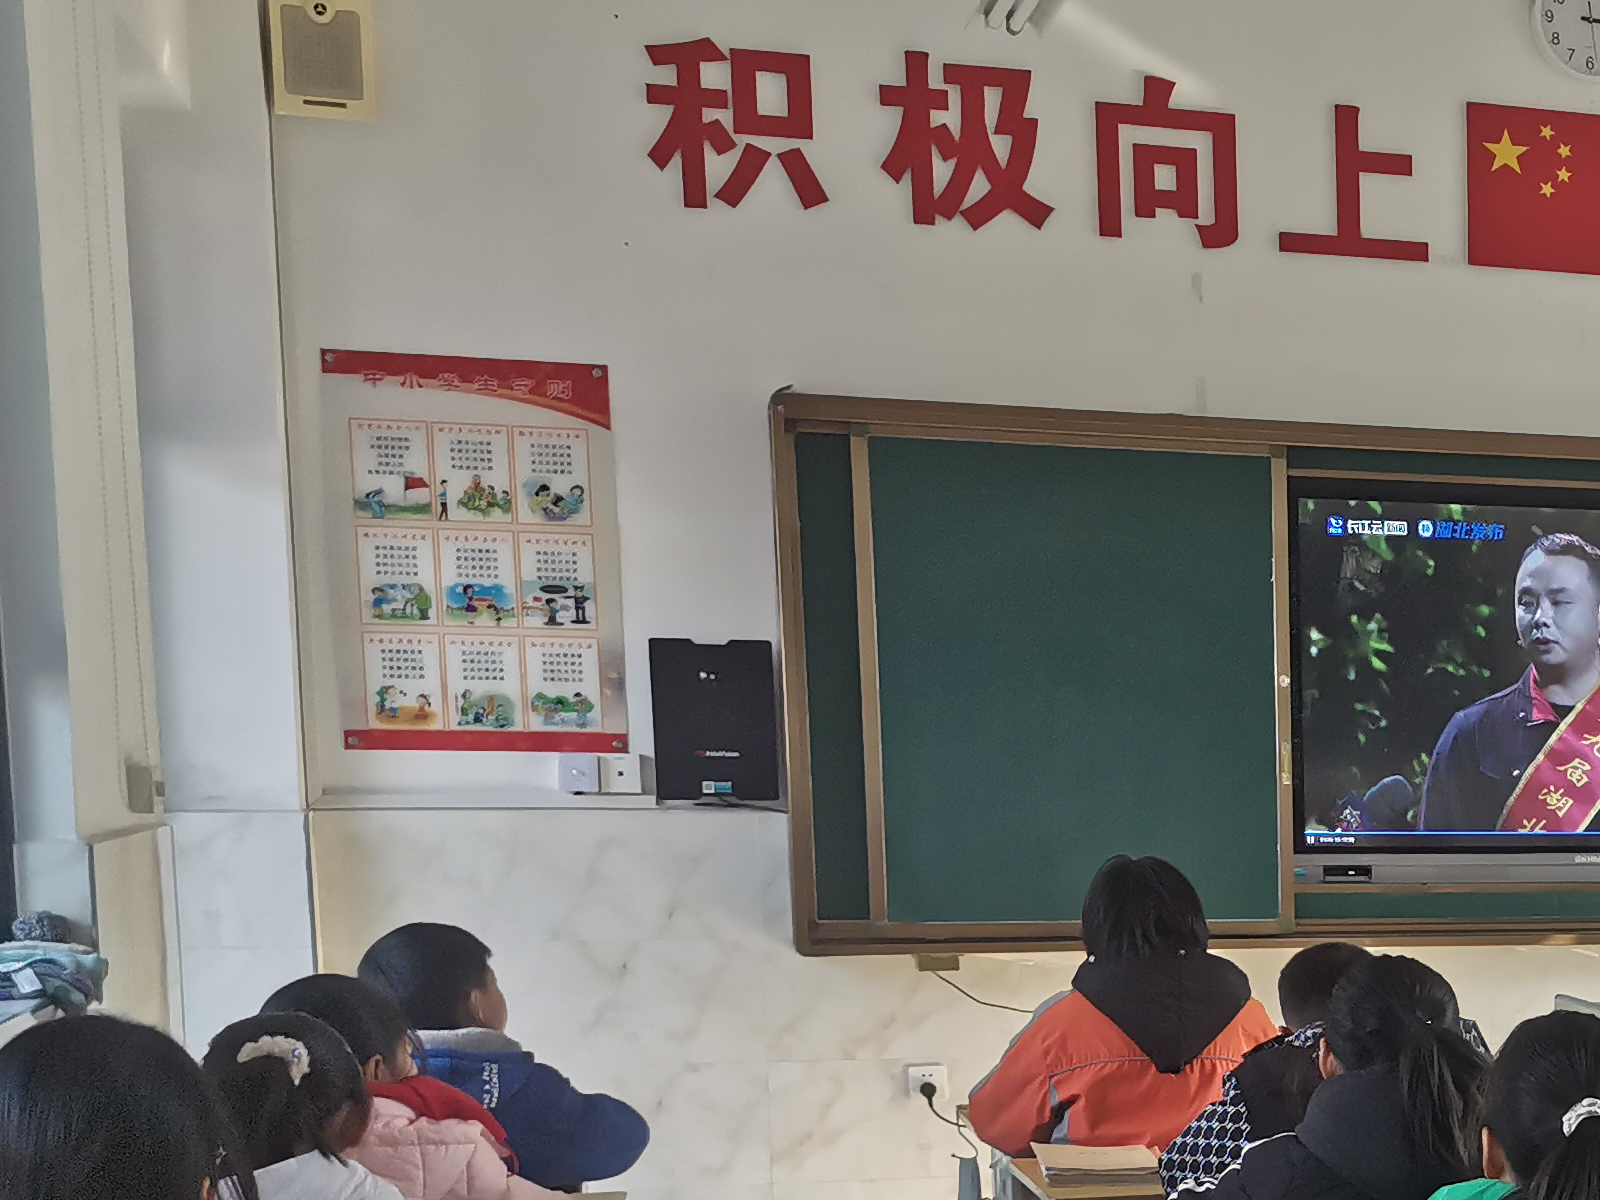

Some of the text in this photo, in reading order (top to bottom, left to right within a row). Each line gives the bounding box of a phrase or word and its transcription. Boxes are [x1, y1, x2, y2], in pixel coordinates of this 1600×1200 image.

[1544, 9, 1554, 23] 9
[1551, 32, 1560, 45] 8
[1566, 48, 1576, 61] 7
[1585, 56, 1595, 70] 6
[645, 36, 1430, 263] 积极向上
[360, 369, 574, 399] 中小学生守则
[1435, 520, 1505, 541] 湖北发布
